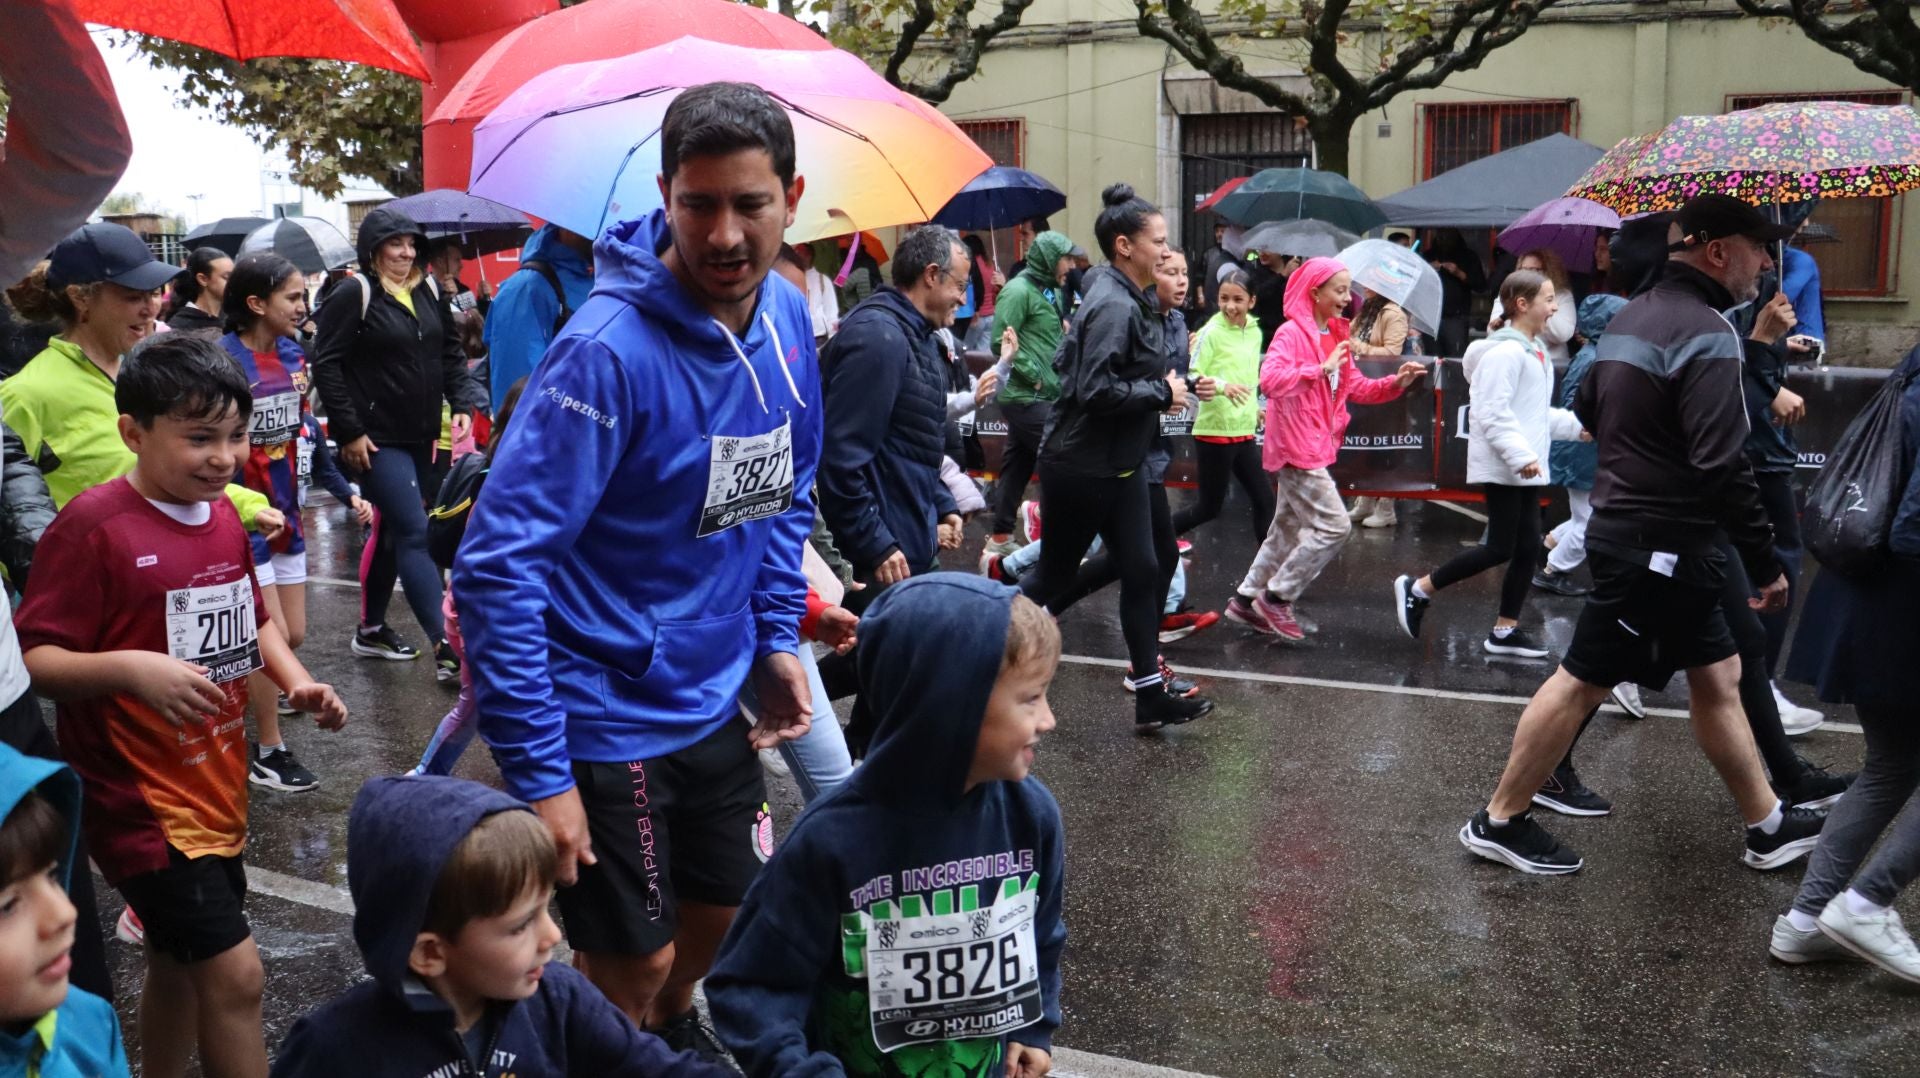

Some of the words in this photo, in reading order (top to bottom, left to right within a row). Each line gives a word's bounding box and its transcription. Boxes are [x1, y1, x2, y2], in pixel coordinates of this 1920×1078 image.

[253, 406, 288, 431] 2621
[1373, 436, 1388, 446] DE
[1392, 432, 1422, 445] LEÓN
[726, 446, 789, 500] 3827
[736, 498, 783, 519] HYUNDAI
[198, 604, 249, 655] 2010
[850, 875, 893, 909] THE
[902, 849, 1034, 893] INCREDIBLE
[903, 932, 1021, 1004] 3826
[943, 1003, 1024, 1032] HYUNDAI
